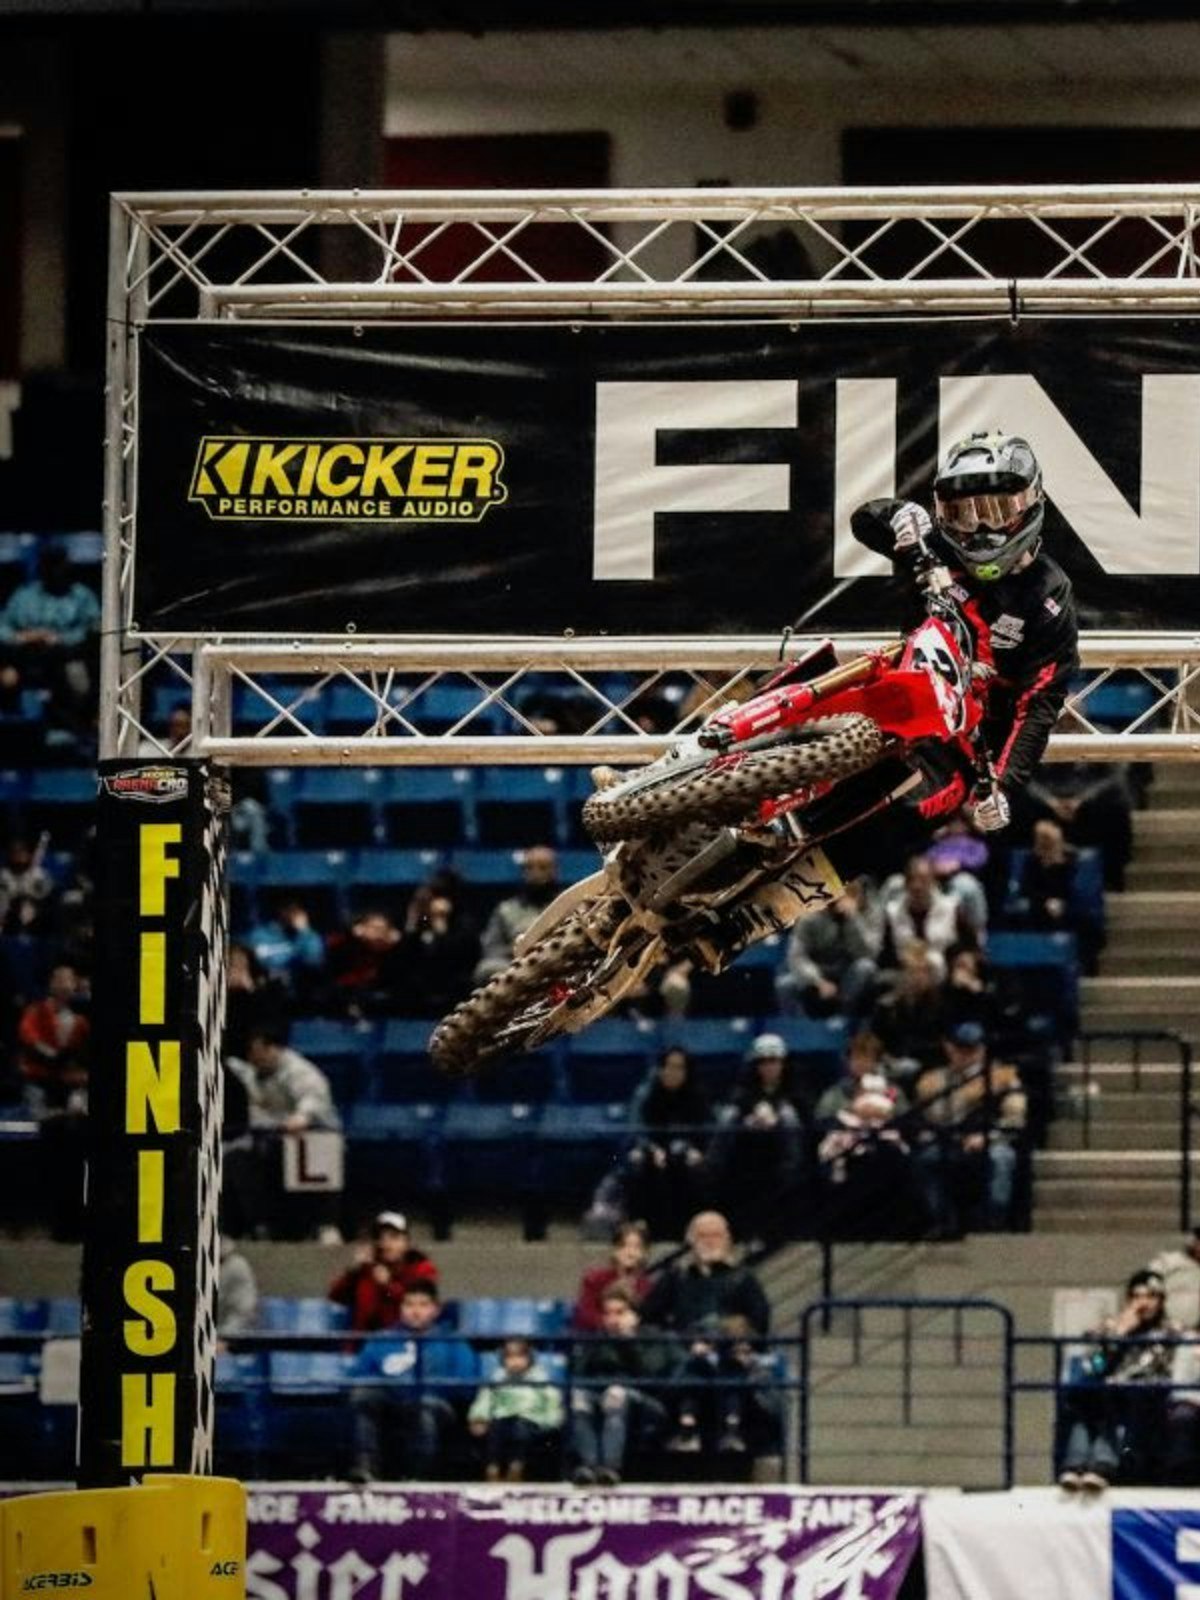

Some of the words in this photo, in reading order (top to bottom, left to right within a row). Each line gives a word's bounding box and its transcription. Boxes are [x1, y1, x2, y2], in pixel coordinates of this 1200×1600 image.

[250, 443, 499, 497] KICKER
[219, 499, 391, 515] PERFORMANCE
[402, 501, 473, 516] AUDIO
[121, 824, 182, 1467] FINISH
[298, 1132, 328, 1184] L
[679, 1496, 764, 1525] RACE
